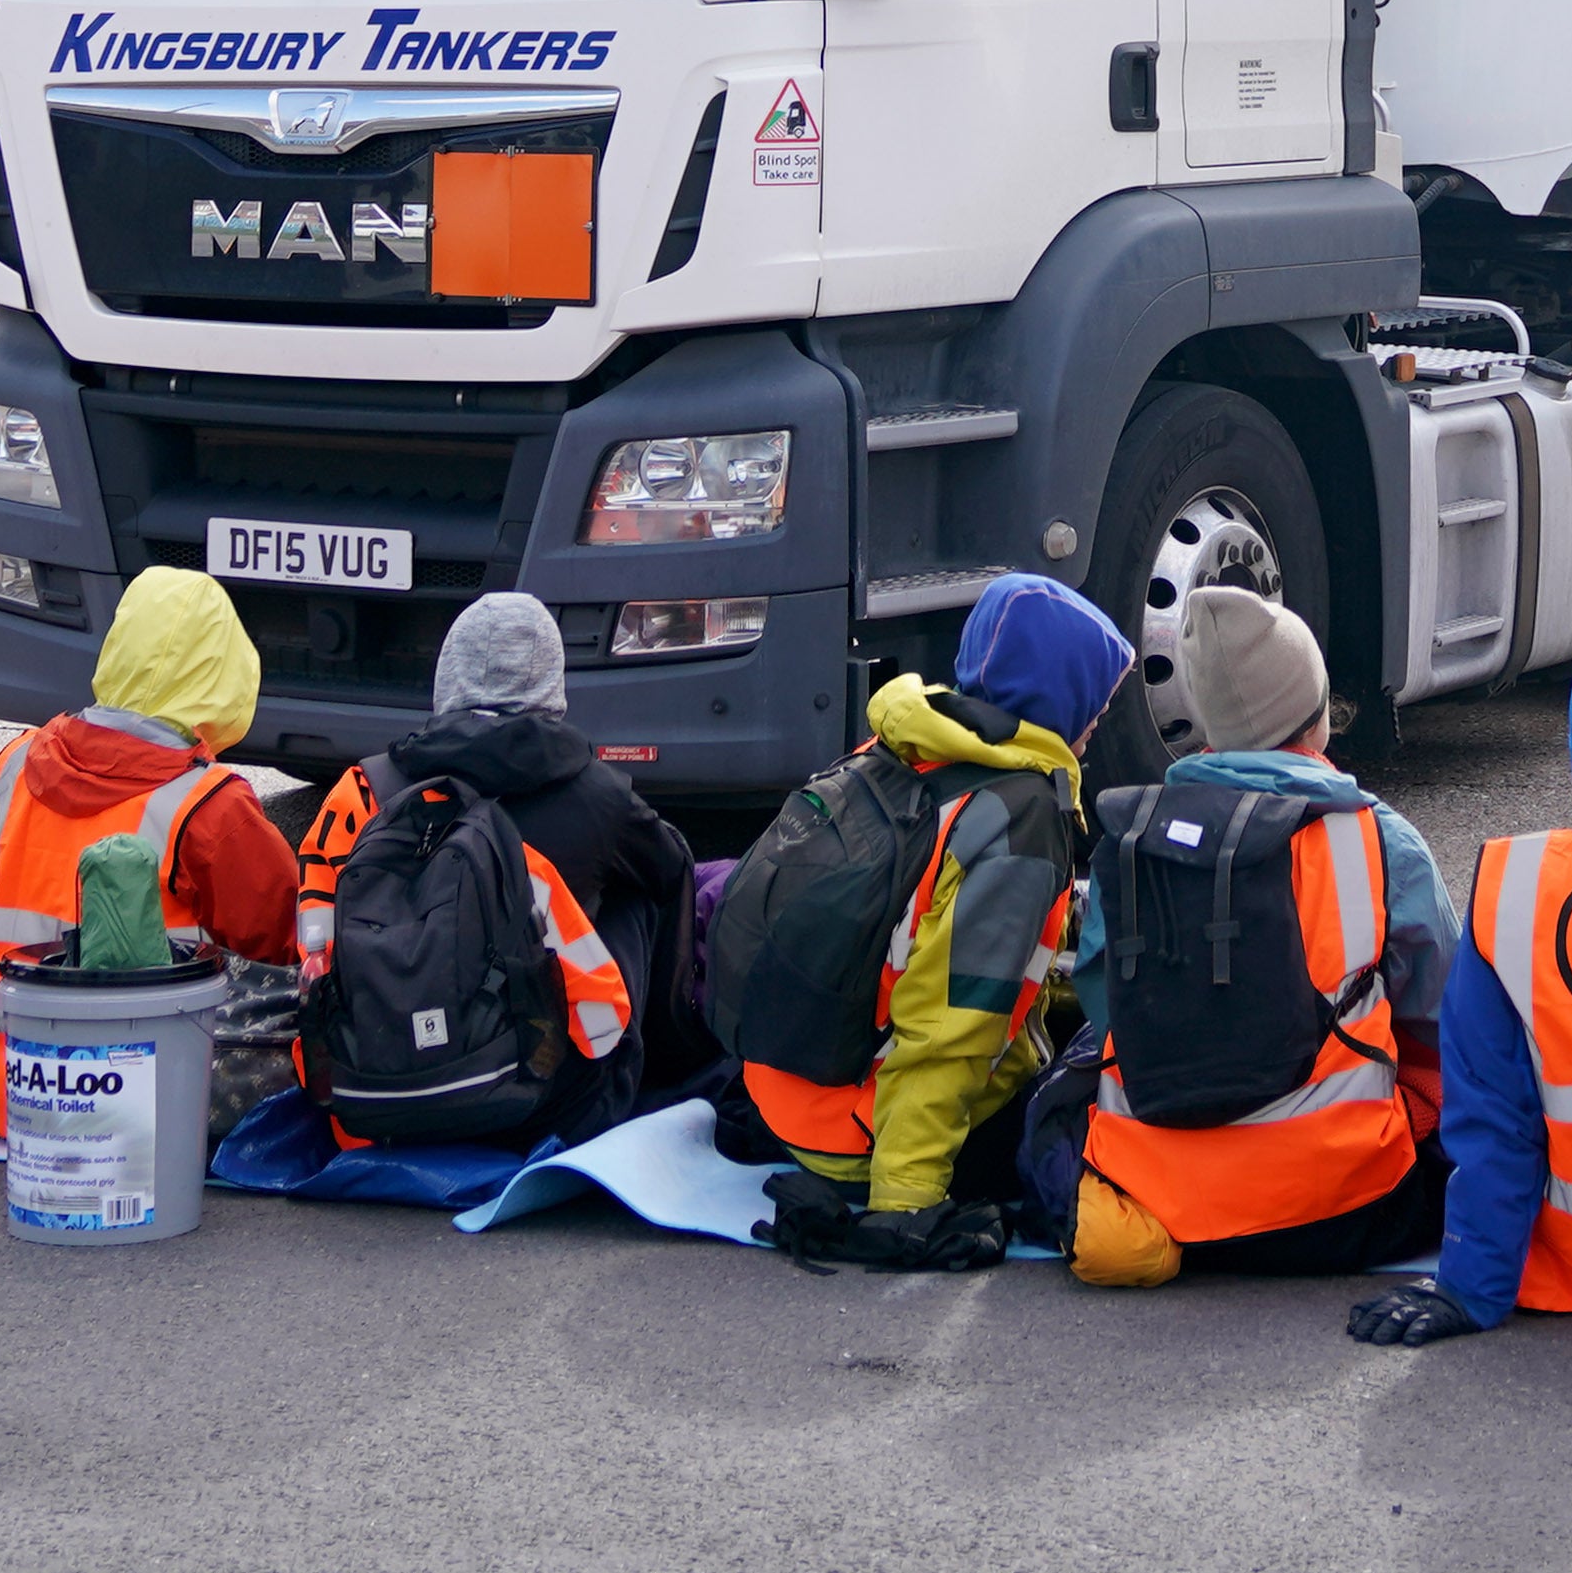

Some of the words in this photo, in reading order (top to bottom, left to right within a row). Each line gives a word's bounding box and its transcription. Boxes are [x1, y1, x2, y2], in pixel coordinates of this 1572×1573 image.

[758, 154, 791, 166] Blind
[794, 154, 817, 168] Spot
[762, 169, 789, 180] Take
[792, 170, 814, 180] care
[191, 199, 427, 263] MAN
[230, 527, 306, 574] DF15
[318, 533, 388, 579] VUG
[5, 1058, 124, 1096] ed-A-Loo
[55, 1099, 96, 1113] Toilet
[83, 1133, 113, 1143] hinged
[93, 1155, 115, 1164] such
[56, 1178, 97, 1186] contoured
[98, 1178, 115, 1188] grip
